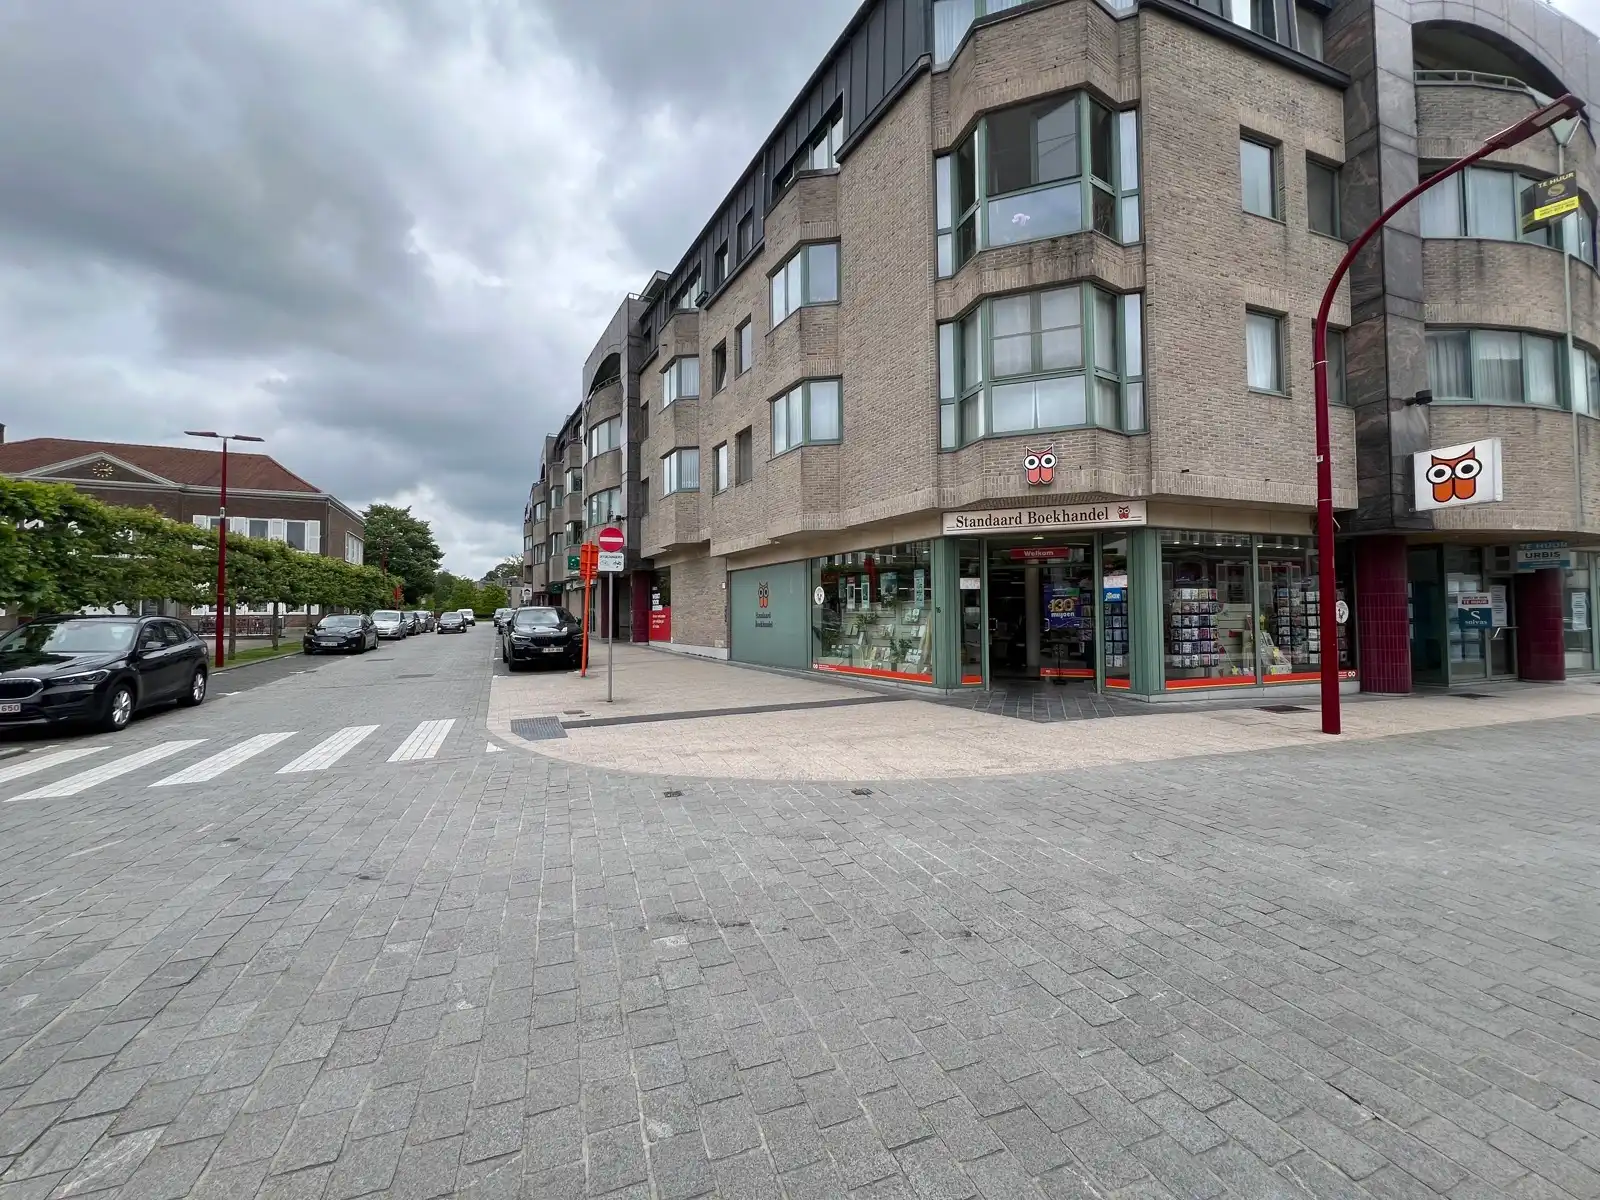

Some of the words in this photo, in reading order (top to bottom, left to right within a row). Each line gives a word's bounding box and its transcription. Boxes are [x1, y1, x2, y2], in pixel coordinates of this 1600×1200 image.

[1550, 172, 1574, 184] HUUR
[955, 512, 1022, 528] Standaard
[1028, 507, 1109, 524] Boekhandel
[1525, 551, 1561, 559] URBIS
[1, 704, 20, 712] 650
